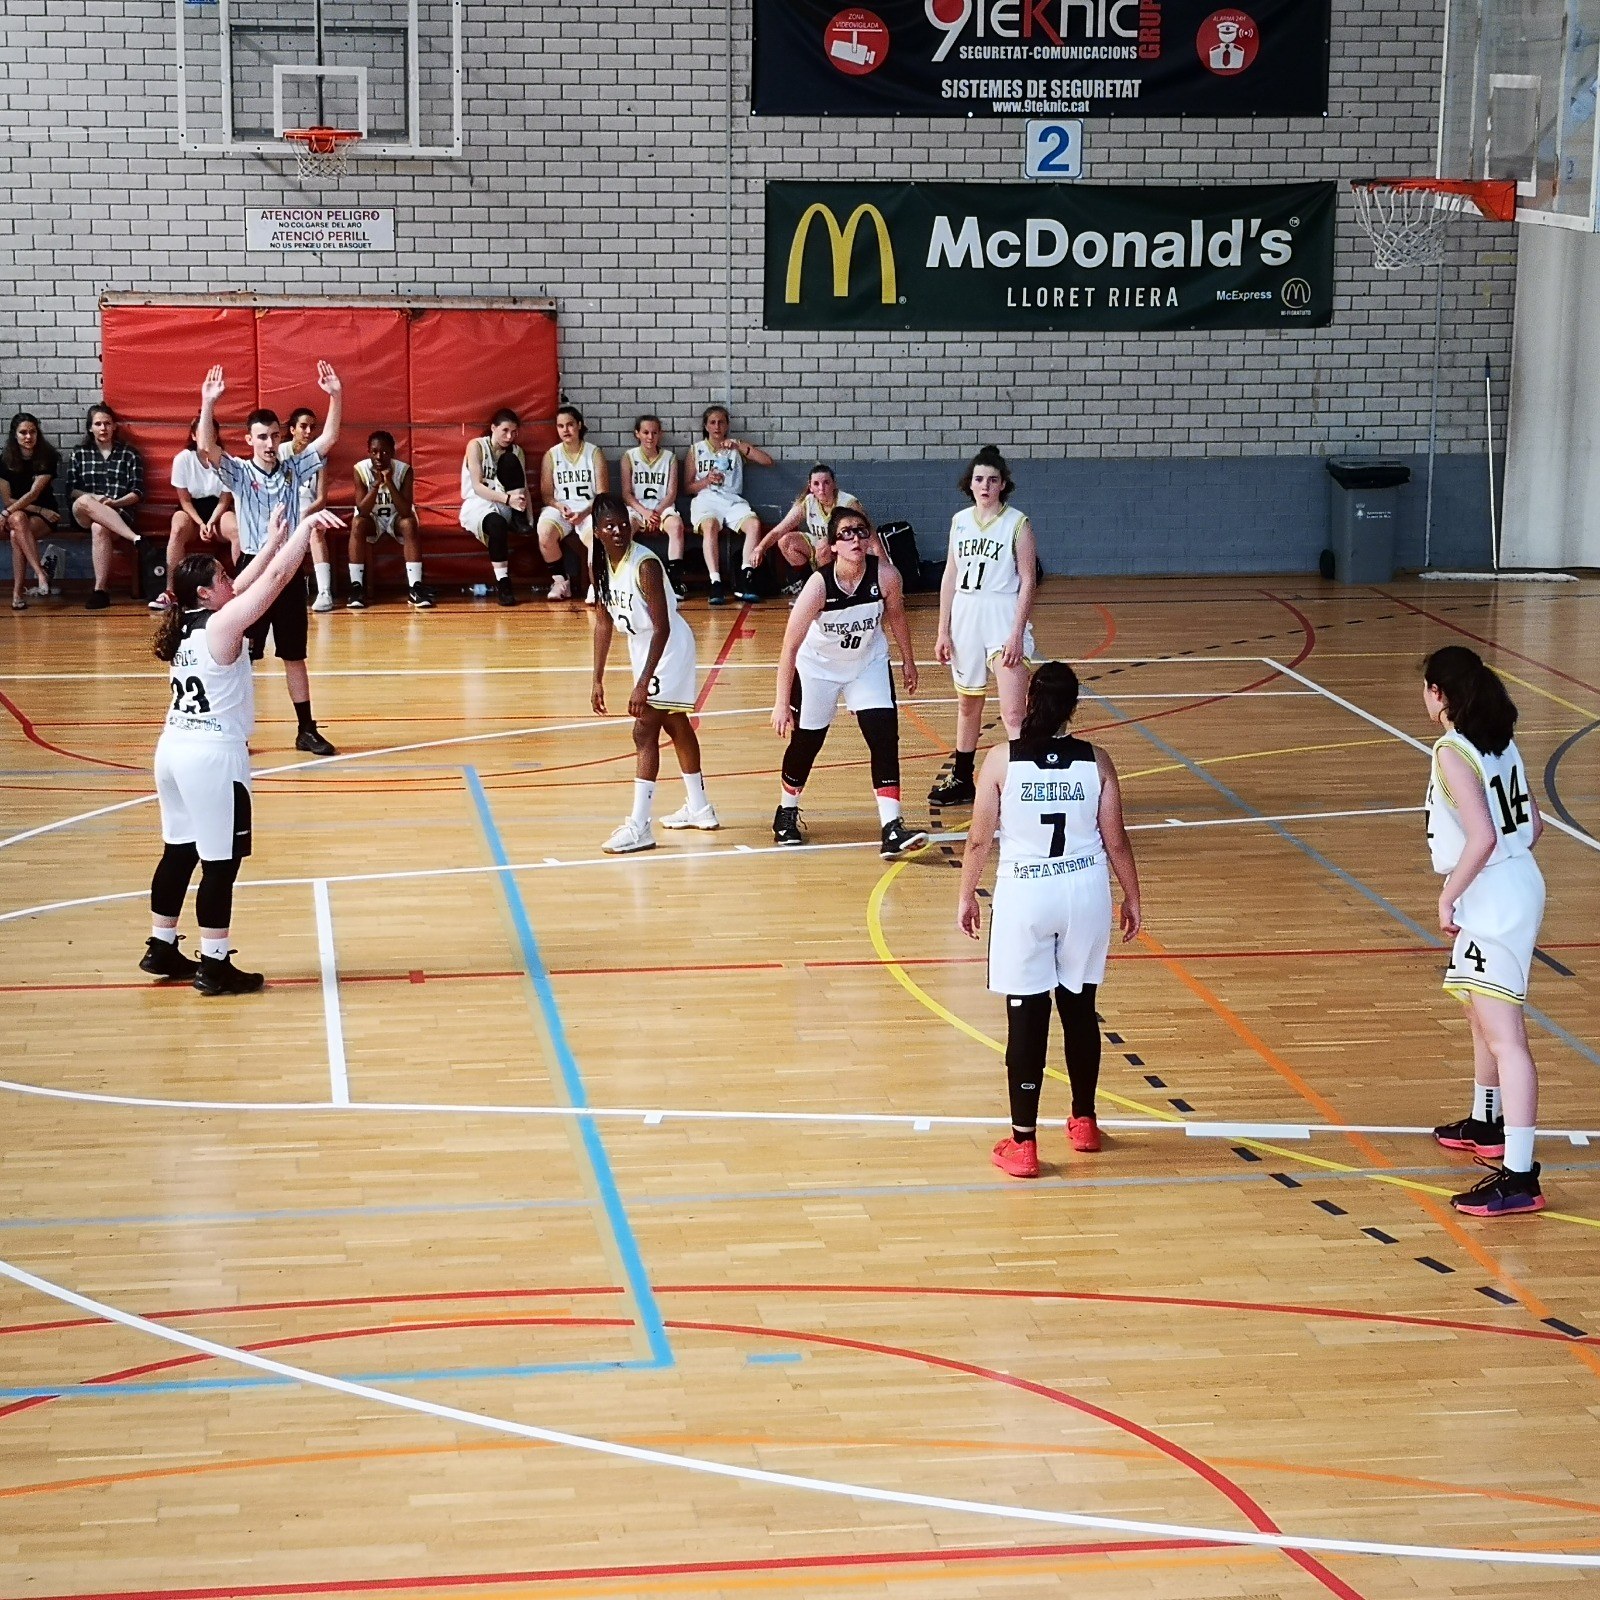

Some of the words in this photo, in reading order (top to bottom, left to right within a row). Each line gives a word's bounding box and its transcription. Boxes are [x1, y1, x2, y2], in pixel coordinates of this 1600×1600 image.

[835, 21, 880, 29] VIDEOVIGILADA
[959, 45, 1138, 60] SEGURETAT-COMUNICACIONS
[941, 79, 1023, 99] SISTEMES
[1026, 79, 1047, 98] DE
[1050, 79, 1142, 98] SEGURETAT
[992, 99, 1090, 113] www.9teknic.cat
[1037, 125, 1070, 172] 2
[260, 210, 323, 221] ATENCION
[327, 210, 380, 221] PELIGRO
[271, 229, 324, 241] ATENCIÓ
[328, 231, 370, 241] PERILL
[925, 214, 1294, 270] McDonald's
[1007, 286, 1096, 307] LLORET
[1108, 287, 1179, 307] RIERA
[1216, 290, 1272, 301] McExpress
[958, 537, 1004, 561] BERNEX
[960, 561, 986, 590] 11
[1020, 782, 1085, 802] ZEHRA
[1489, 764, 1529, 836] 14
[1040, 812, 1066, 858] 7
